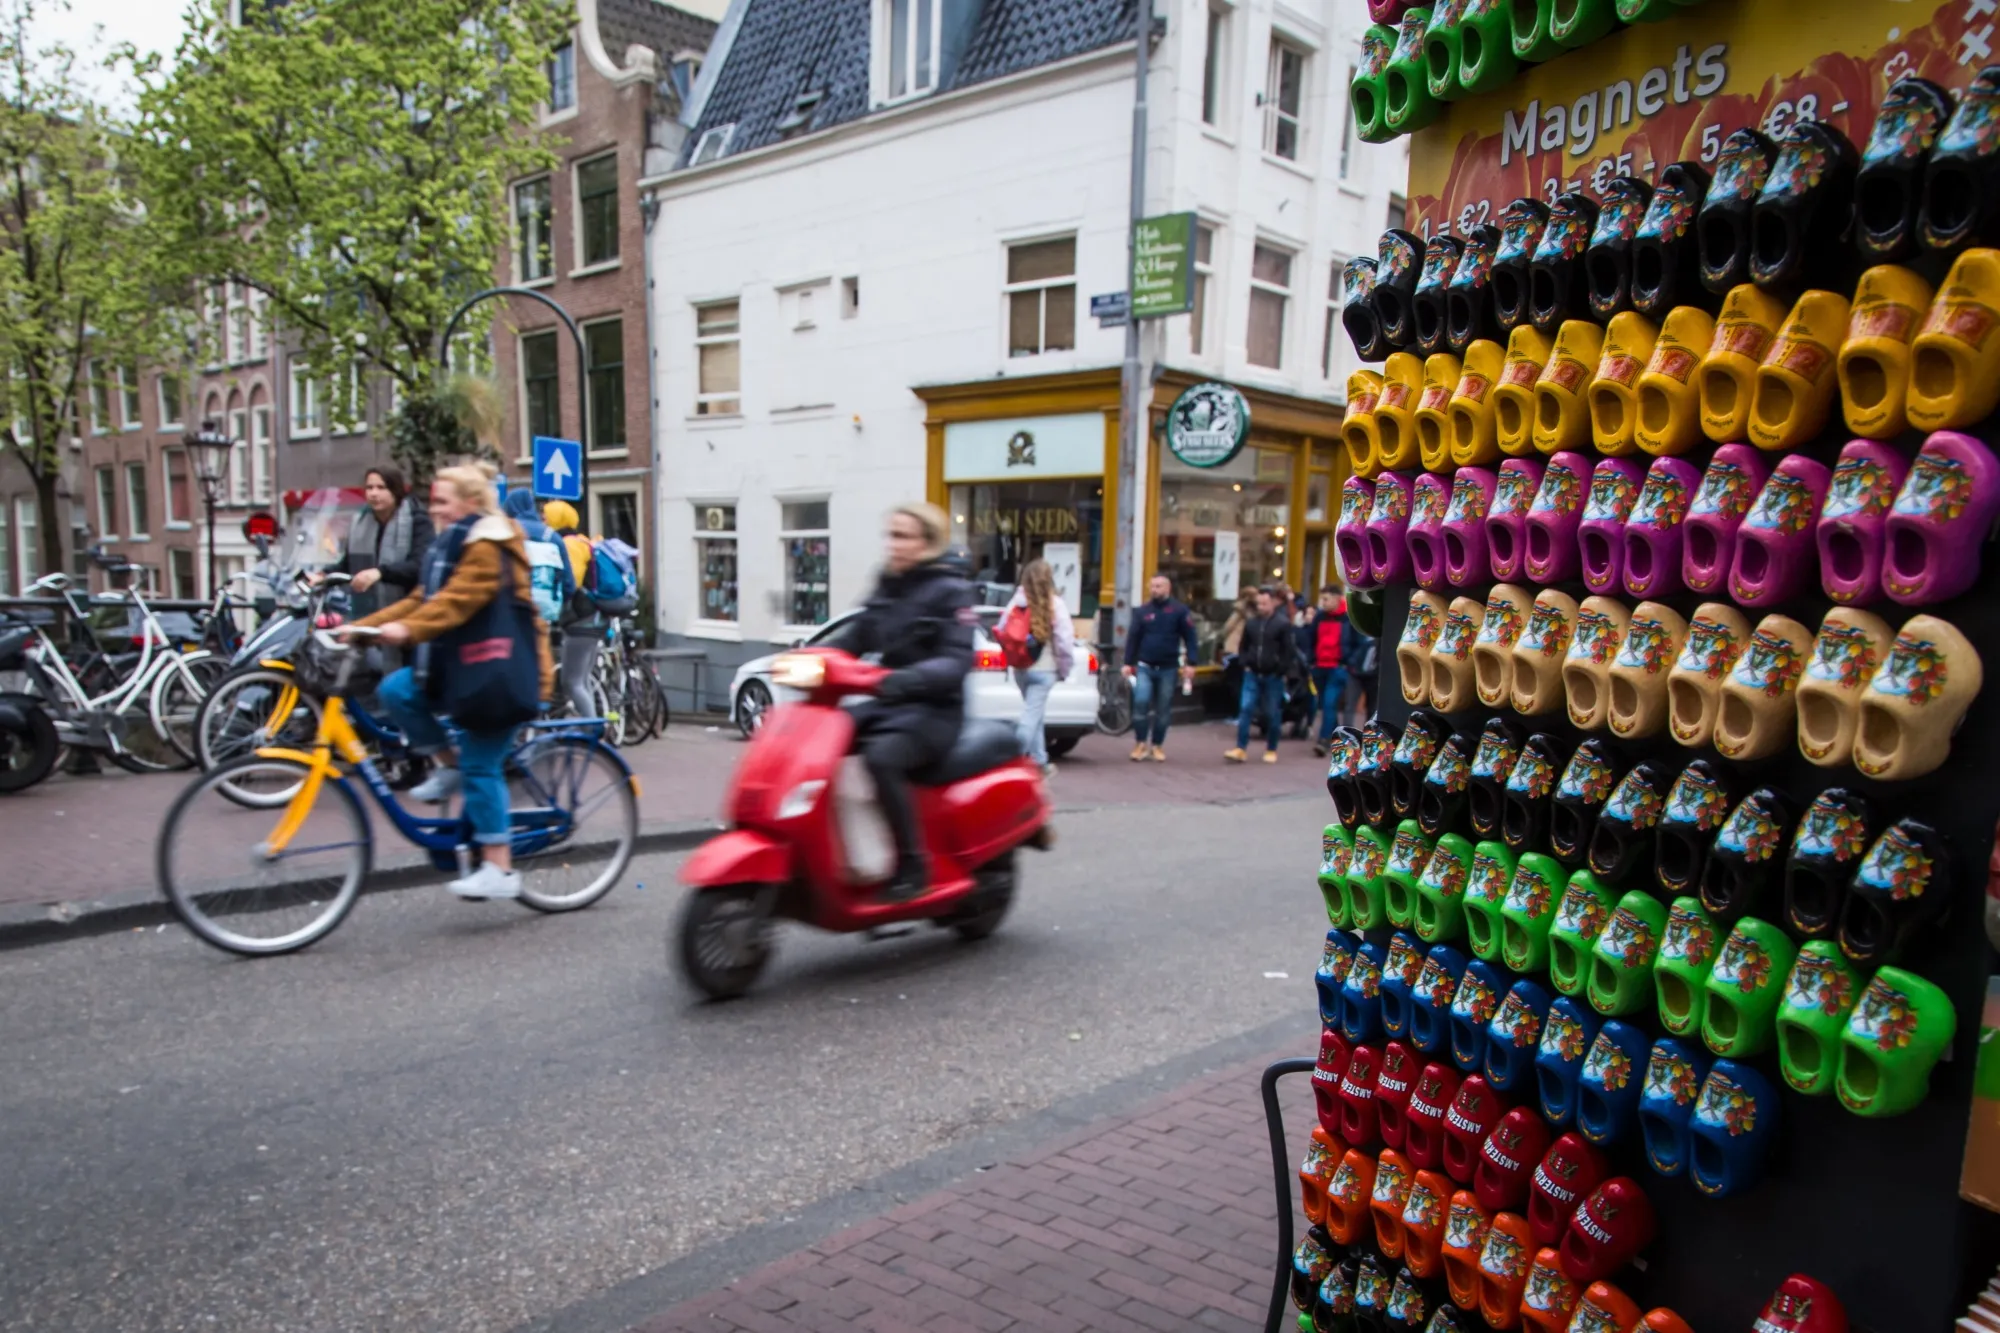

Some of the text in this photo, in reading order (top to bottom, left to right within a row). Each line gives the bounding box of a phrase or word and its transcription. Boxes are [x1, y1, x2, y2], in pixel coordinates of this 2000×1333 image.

[1501, 44, 1727, 166] Magnets
[1590, 153, 1655, 194] €5-
[1700, 124, 1720, 162] 5
[1763, 94, 1848, 141] €8-
[1501, 436, 1520, 446] Holland
[1535, 436, 1555, 446] Holland
[1637, 431, 1662, 448] Holland
[1752, 424, 1781, 441] Holland
[1598, 440, 1622, 449] Holland
[1025, 508, 1078, 534] SEEDS
